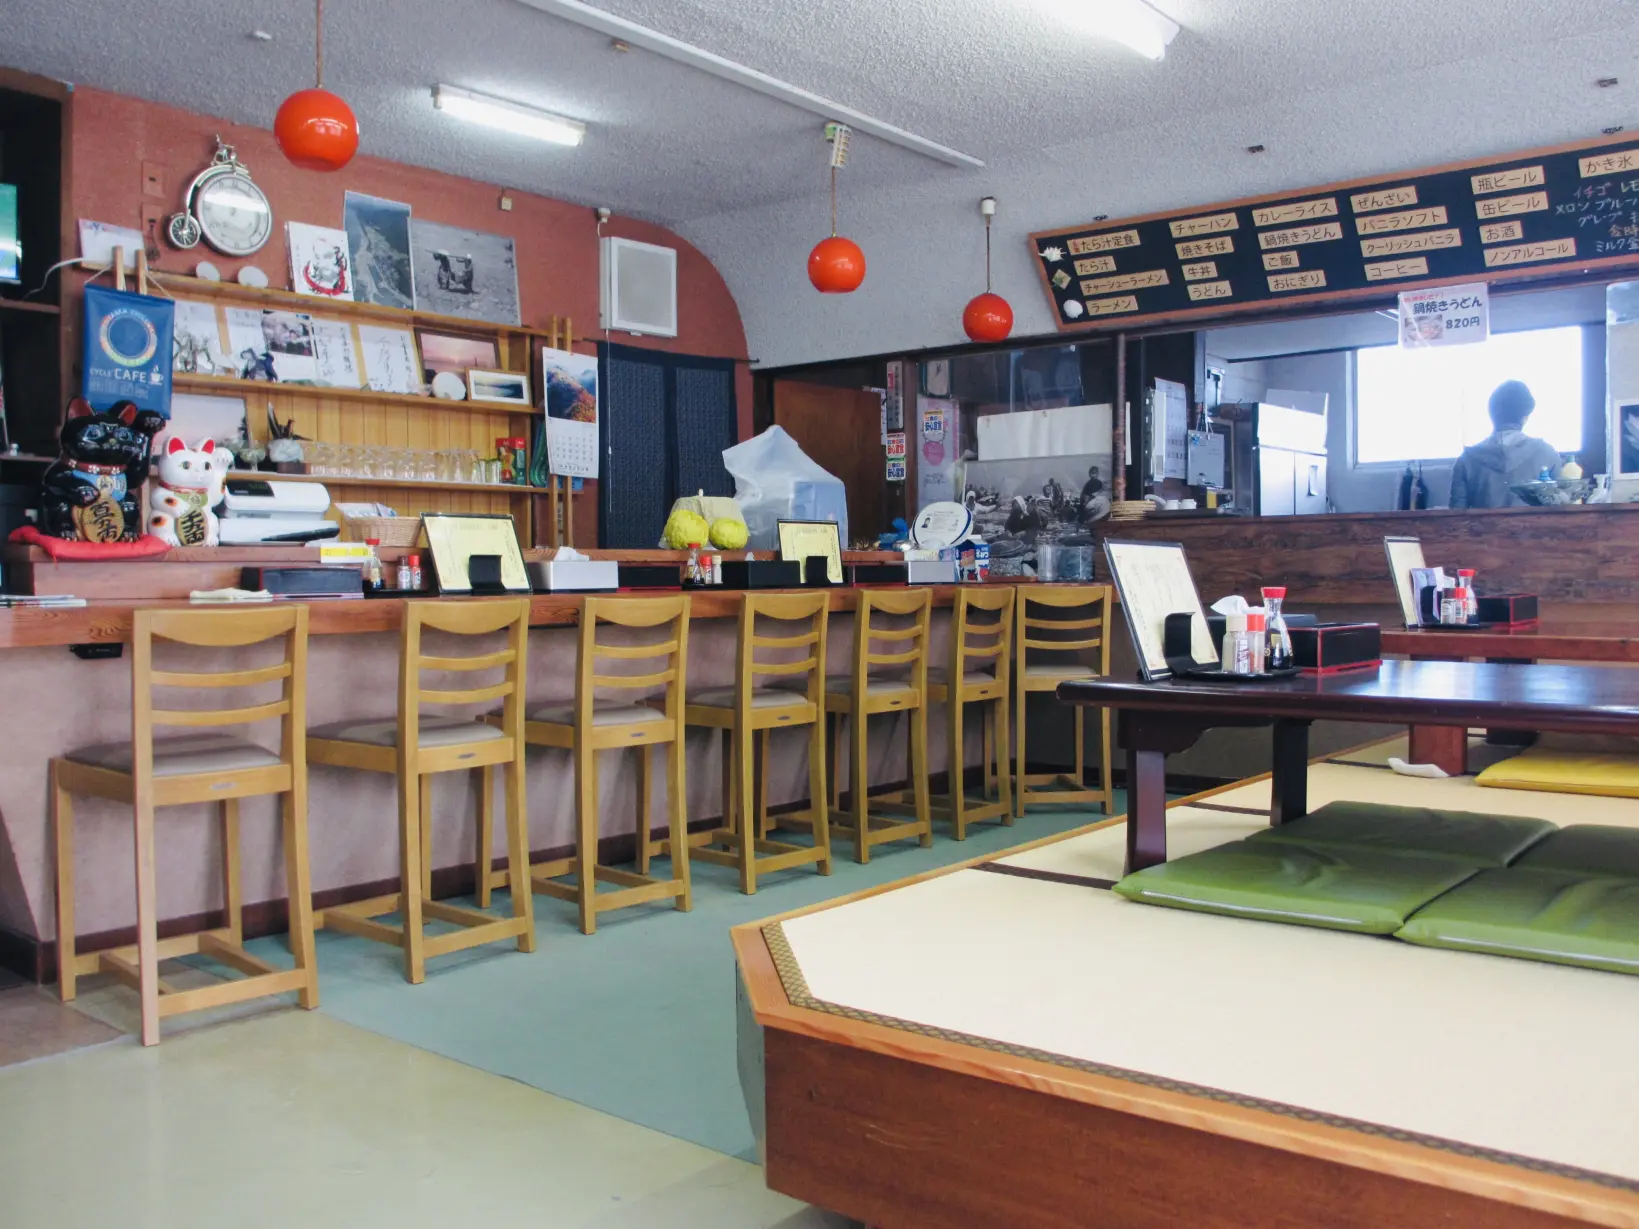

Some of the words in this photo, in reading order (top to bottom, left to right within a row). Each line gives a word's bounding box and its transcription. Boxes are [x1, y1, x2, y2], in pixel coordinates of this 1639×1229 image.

[1586, 154, 1634, 174] かき氷
[1478, 171, 1537, 191] 瓶ビール
[1573, 182, 1612, 199] イチゴ
[1357, 192, 1410, 210] ぜんざい
[1482, 196, 1540, 216] 缶ビール
[1258, 202, 1333, 223] カレーライス
[1363, 210, 1441, 231] バニラソフト
[1175, 217, 1232, 235] チャーハン
[1486, 225, 1515, 241] お酒
[1081, 234, 1136, 251] たら汁定食
[1263, 229, 1336, 247] 鍋焼きうどん
[1366, 233, 1455, 255] クーリッシュバニラ
[1181, 240, 1226, 257] 焼きそば
[1490, 242, 1569, 263] ノンアルコール
[1079, 260, 1110, 272] たら汁
[1268, 254, 1293, 267] ご飯
[1188, 265, 1212, 277] 牛丼
[1369, 263, 1422, 278] コーヒー
[1084, 273, 1163, 293] チャーシューラーメン
[1273, 274, 1320, 290] おにぎり
[1192, 284, 1226, 298] うどん
[1091, 300, 1131, 312] ラーメン
[1412, 296, 1483, 316] 鍋焼きうどん
[1445, 316, 1481, 330] 820円
[114, 367, 147, 384] CAFE
